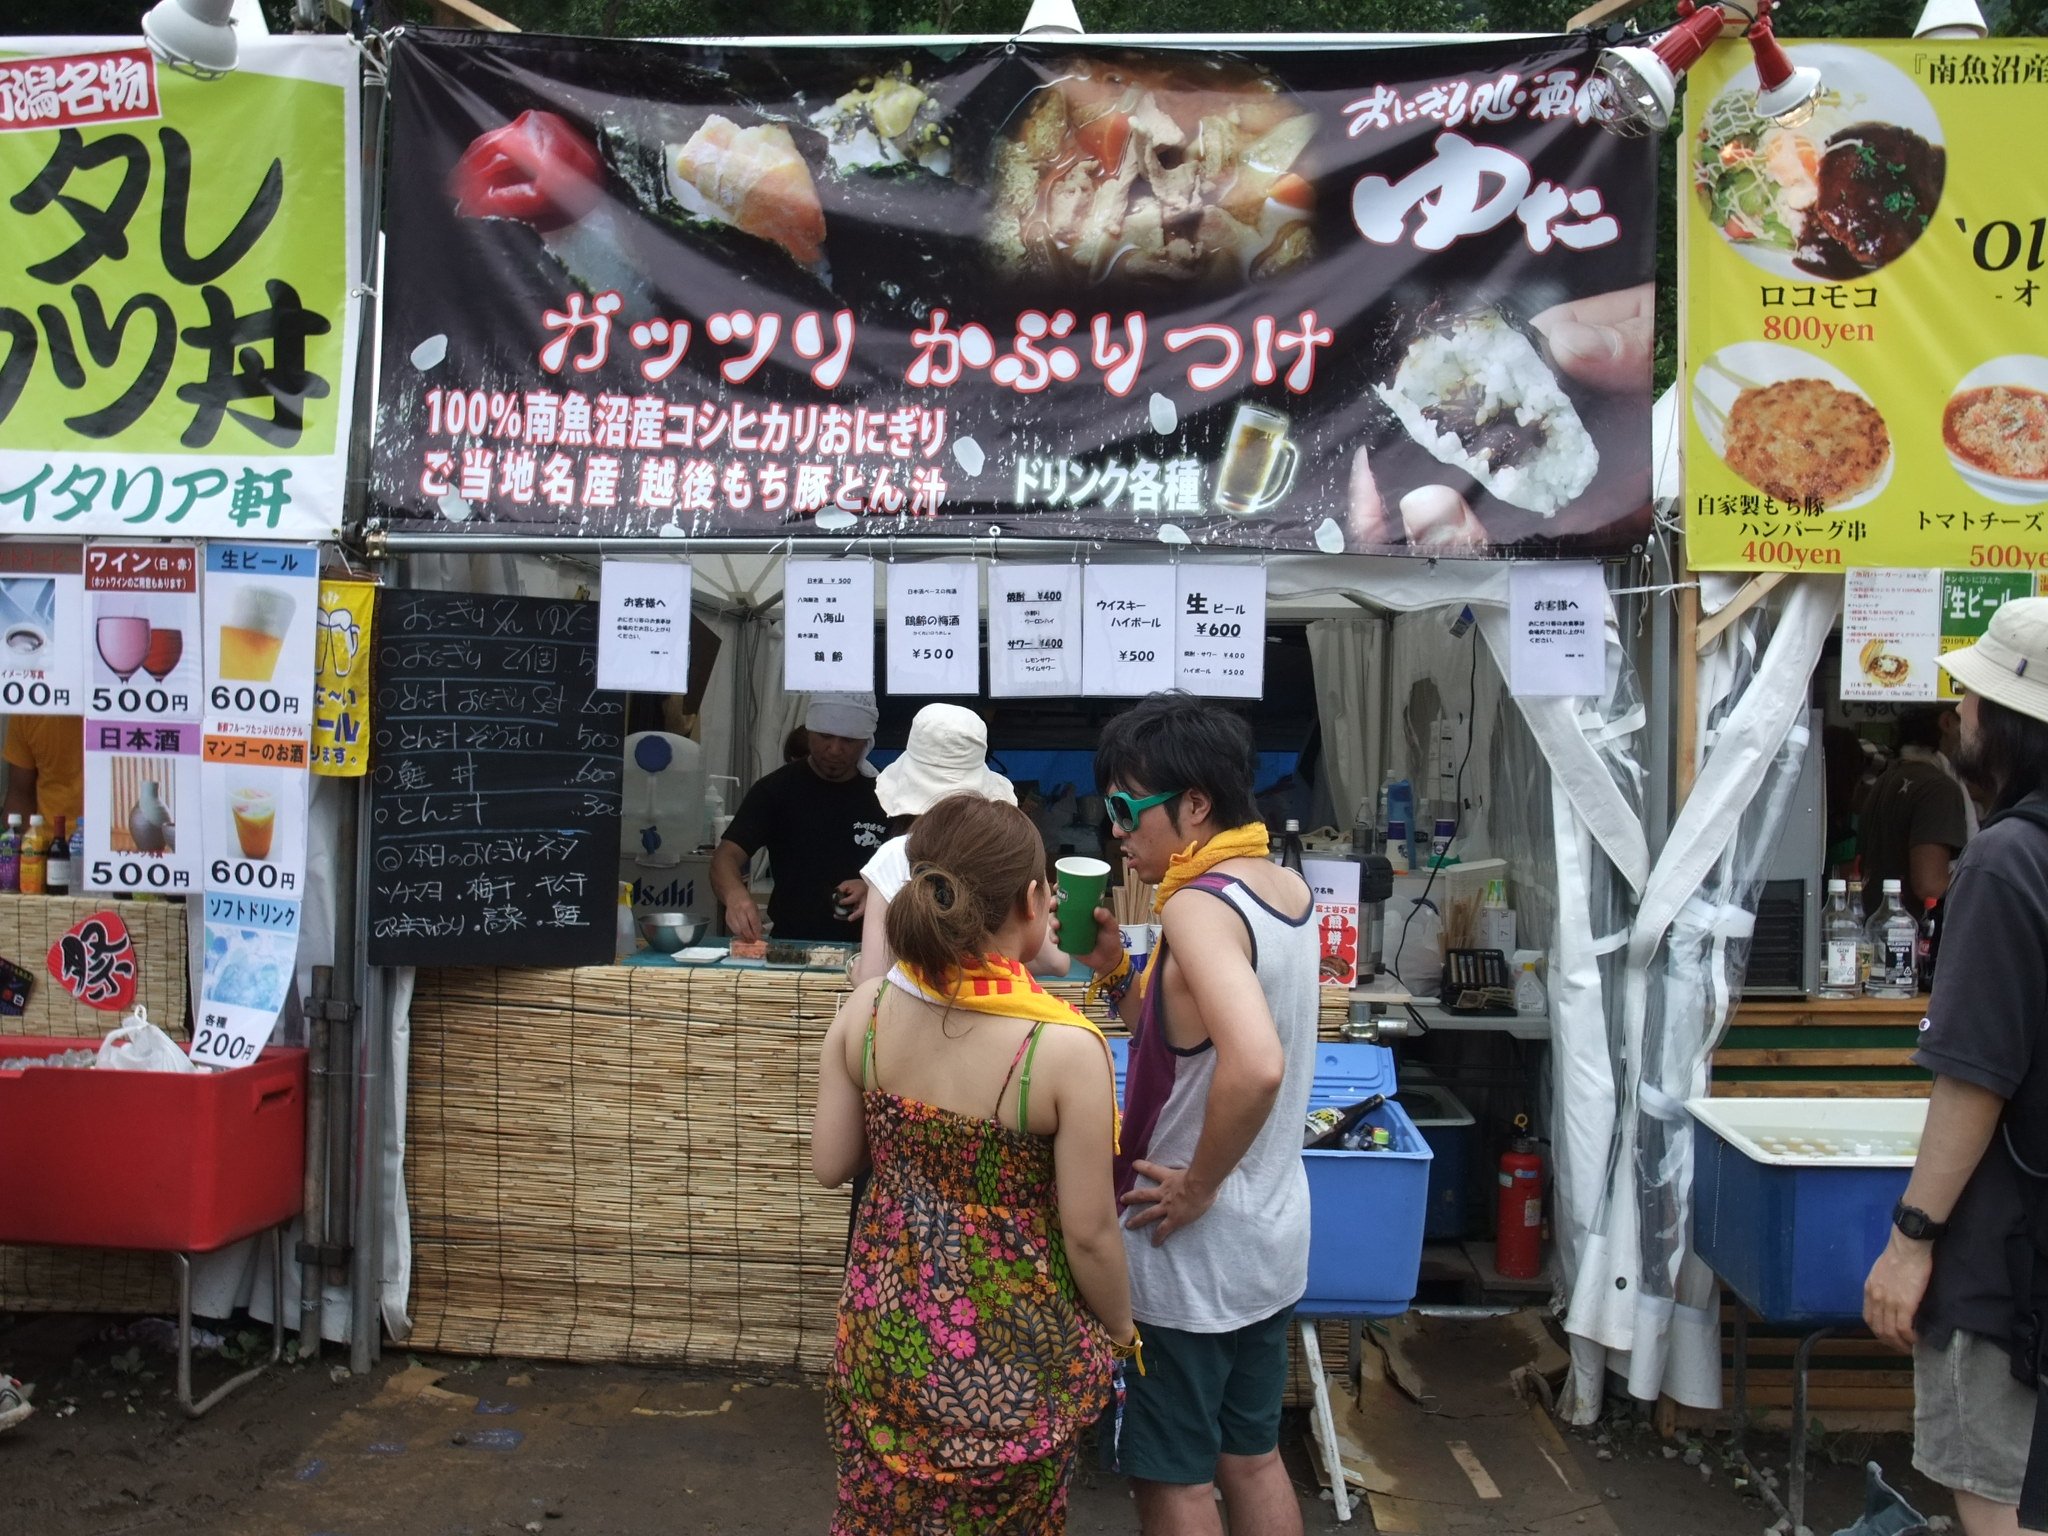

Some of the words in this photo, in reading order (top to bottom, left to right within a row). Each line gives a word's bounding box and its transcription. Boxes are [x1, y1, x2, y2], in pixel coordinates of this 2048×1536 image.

[1760, 285, 1877, 309] ロコモコ
[1763, 316, 1874, 349] 800yen
[905, 307, 1334, 396] かぶりつけ
[419, 449, 621, 507] ご当地名産
[1015, 456, 1201, 511] ドリンク各種
[1698, 493, 1824, 517] 自家製もち豚
[1739, 520, 1867, 542] ハンバーグ串
[1918, 510, 2042, 533] トマトチーズ
[221, 550, 298, 571] 生ビール
[1741, 540, 1841, 570] 400yen
[624, 597, 666, 608] お客様へ
[1534, 600, 1579, 611] お客様へ
[813, 613, 845, 623] 八海山
[1111, 617, 1162, 629] ハイボール
[1196, 622, 1241, 637] ¥600
[913, 648, 954, 659] ¥500
[1119, 650, 1155, 662] ¥500
[92, 688, 188, 713] 500円
[211, 686, 299, 714] 600円
[100, 728, 180, 752] 日本酒
[206, 740, 305, 764] マンゴーのお酒
[91, 862, 190, 888] 500円
[211, 860, 295, 890] 600円
[210, 898, 295, 927] ソフトドリンク
[205, 1014, 227, 1030] 各種
[196, 1030, 256, 1061] 200円
